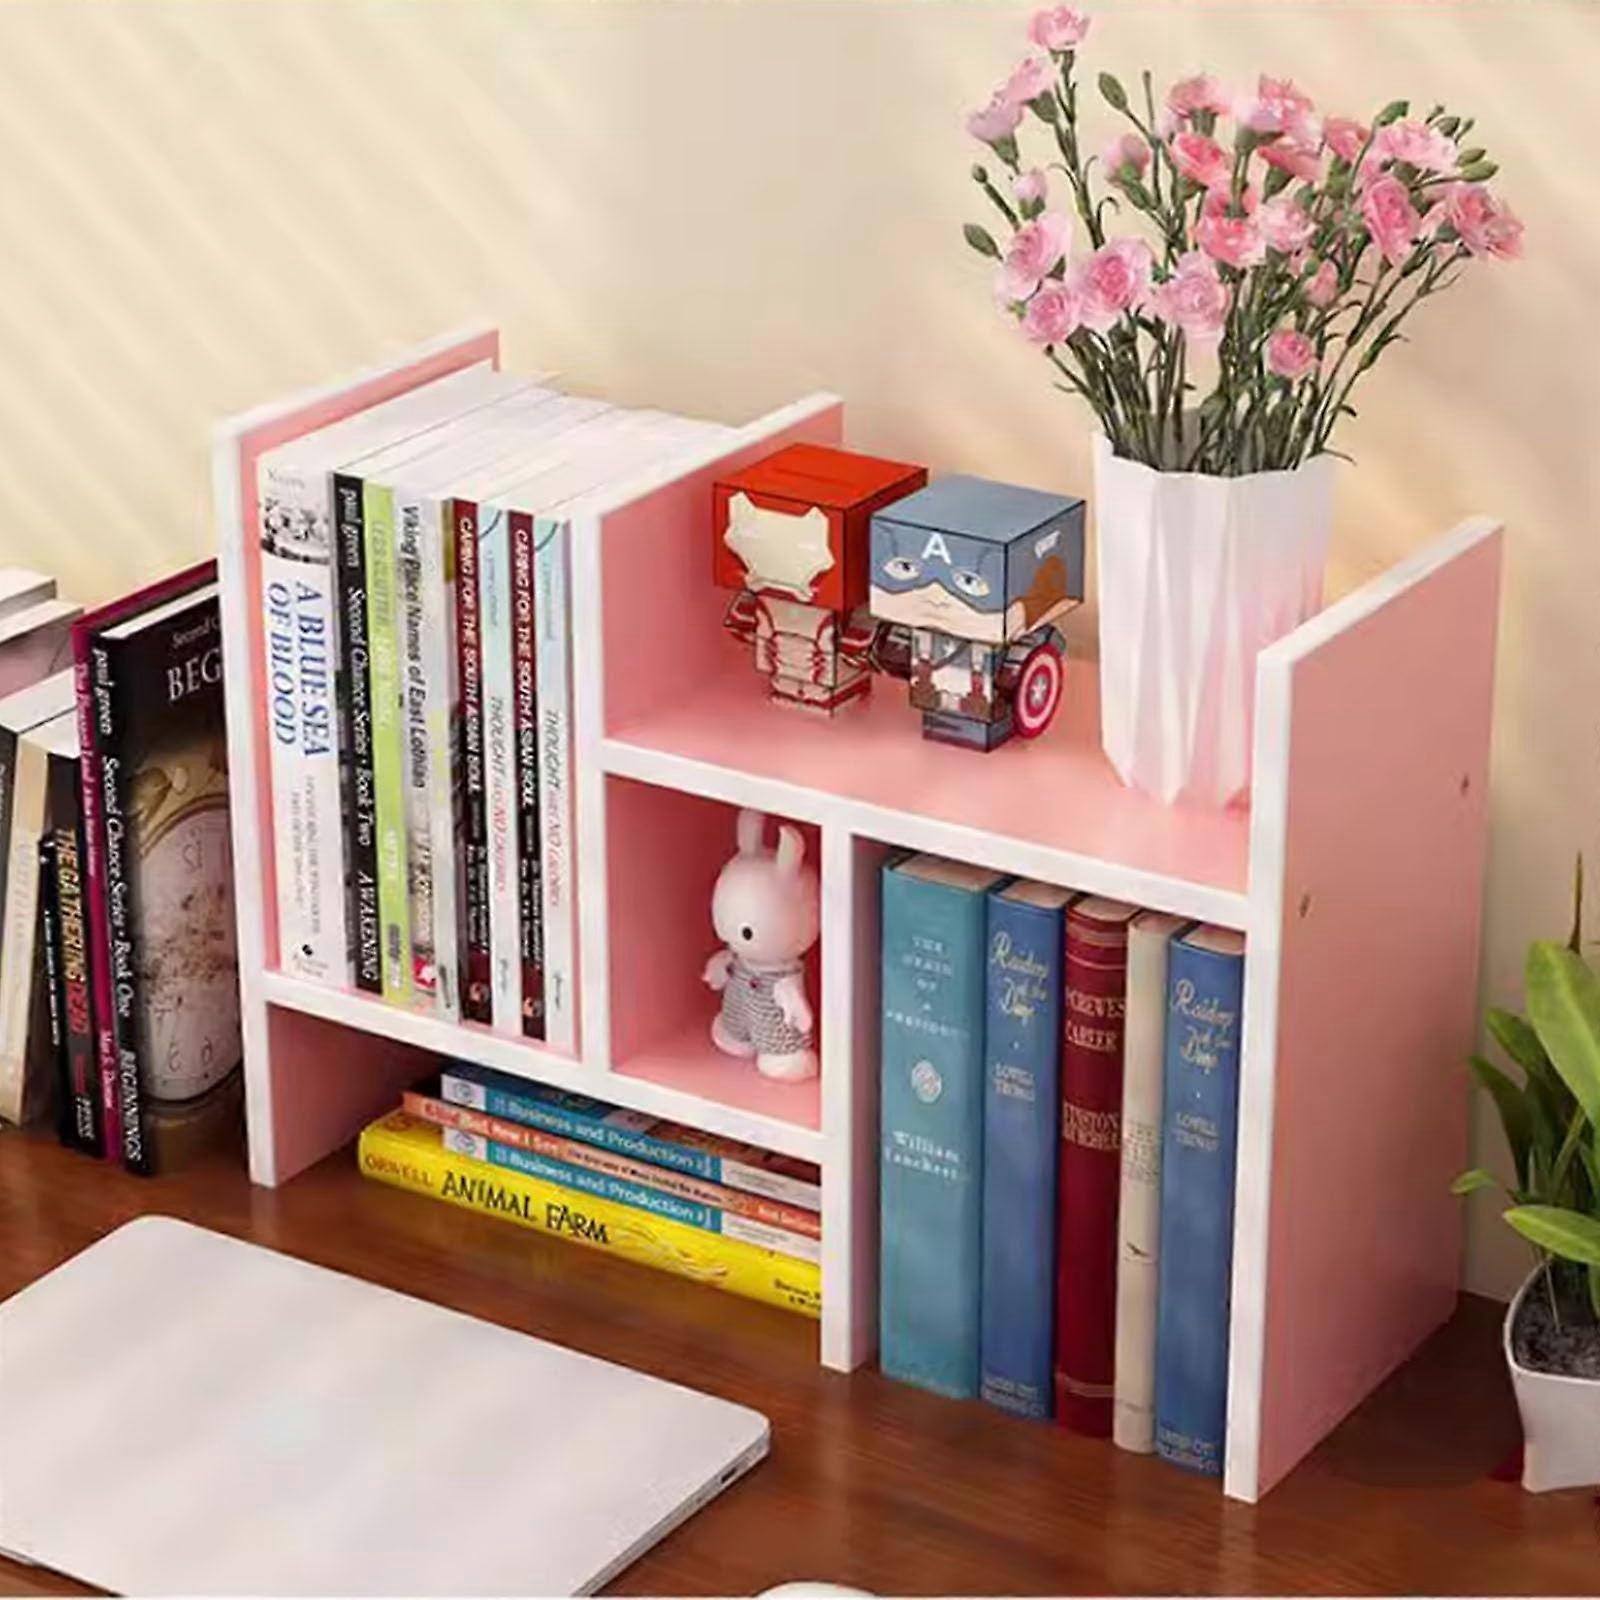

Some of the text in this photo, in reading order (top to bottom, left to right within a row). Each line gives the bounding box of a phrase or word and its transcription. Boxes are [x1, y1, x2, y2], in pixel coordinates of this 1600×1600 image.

[401, 505, 420, 557] Viking
[459, 517, 475, 575] CARING
[921, 532, 952, 564] A
[404, 557, 421, 602] Place
[515, 529, 529, 588] CARING
[295, 580, 323, 602] A
[348, 587, 367, 646] Second
[462, 576, 477, 611] FOR
[517, 589, 530, 624] FOR
[406, 604, 423, 662] Names
[463, 612, 478, 646] THE
[518, 626, 531, 660] THE
[269, 581, 297, 746] OF BLOOD
[298, 614, 328, 698] BLUE
[351, 646, 369, 707] Chance
[408, 665, 426, 686] of
[464, 647, 478, 703] SOUTH
[409, 686, 427, 725] East
[518, 660, 532, 716] SOUTH
[302, 700, 331, 757] SEA
[353, 709, 371, 759] Series
[465, 703, 481, 752] ASIAN
[520, 716, 534, 766] ASIAN
[102, 755, 121, 817] Second
[466, 753, 482, 795] SOUL
[521, 767, 535, 809] SOUL
[55, 828, 77, 866] THE
[107, 817, 124, 879] Chance
[357, 811, 374, 847] Two
[59, 866, 85, 982] GATHERING
[110, 880, 128, 932] Series
[357, 870, 379, 981] AWAKENING
[66, 982, 89, 1034] DEAD
[116, 983, 134, 1018] One
[119, 1048, 142, 1162] BEGINNINGS
[441, 1169, 537, 1222] ANIMAL
[545, 1203, 610, 1243] FARM
[608, 1180, 694, 1219] Production
